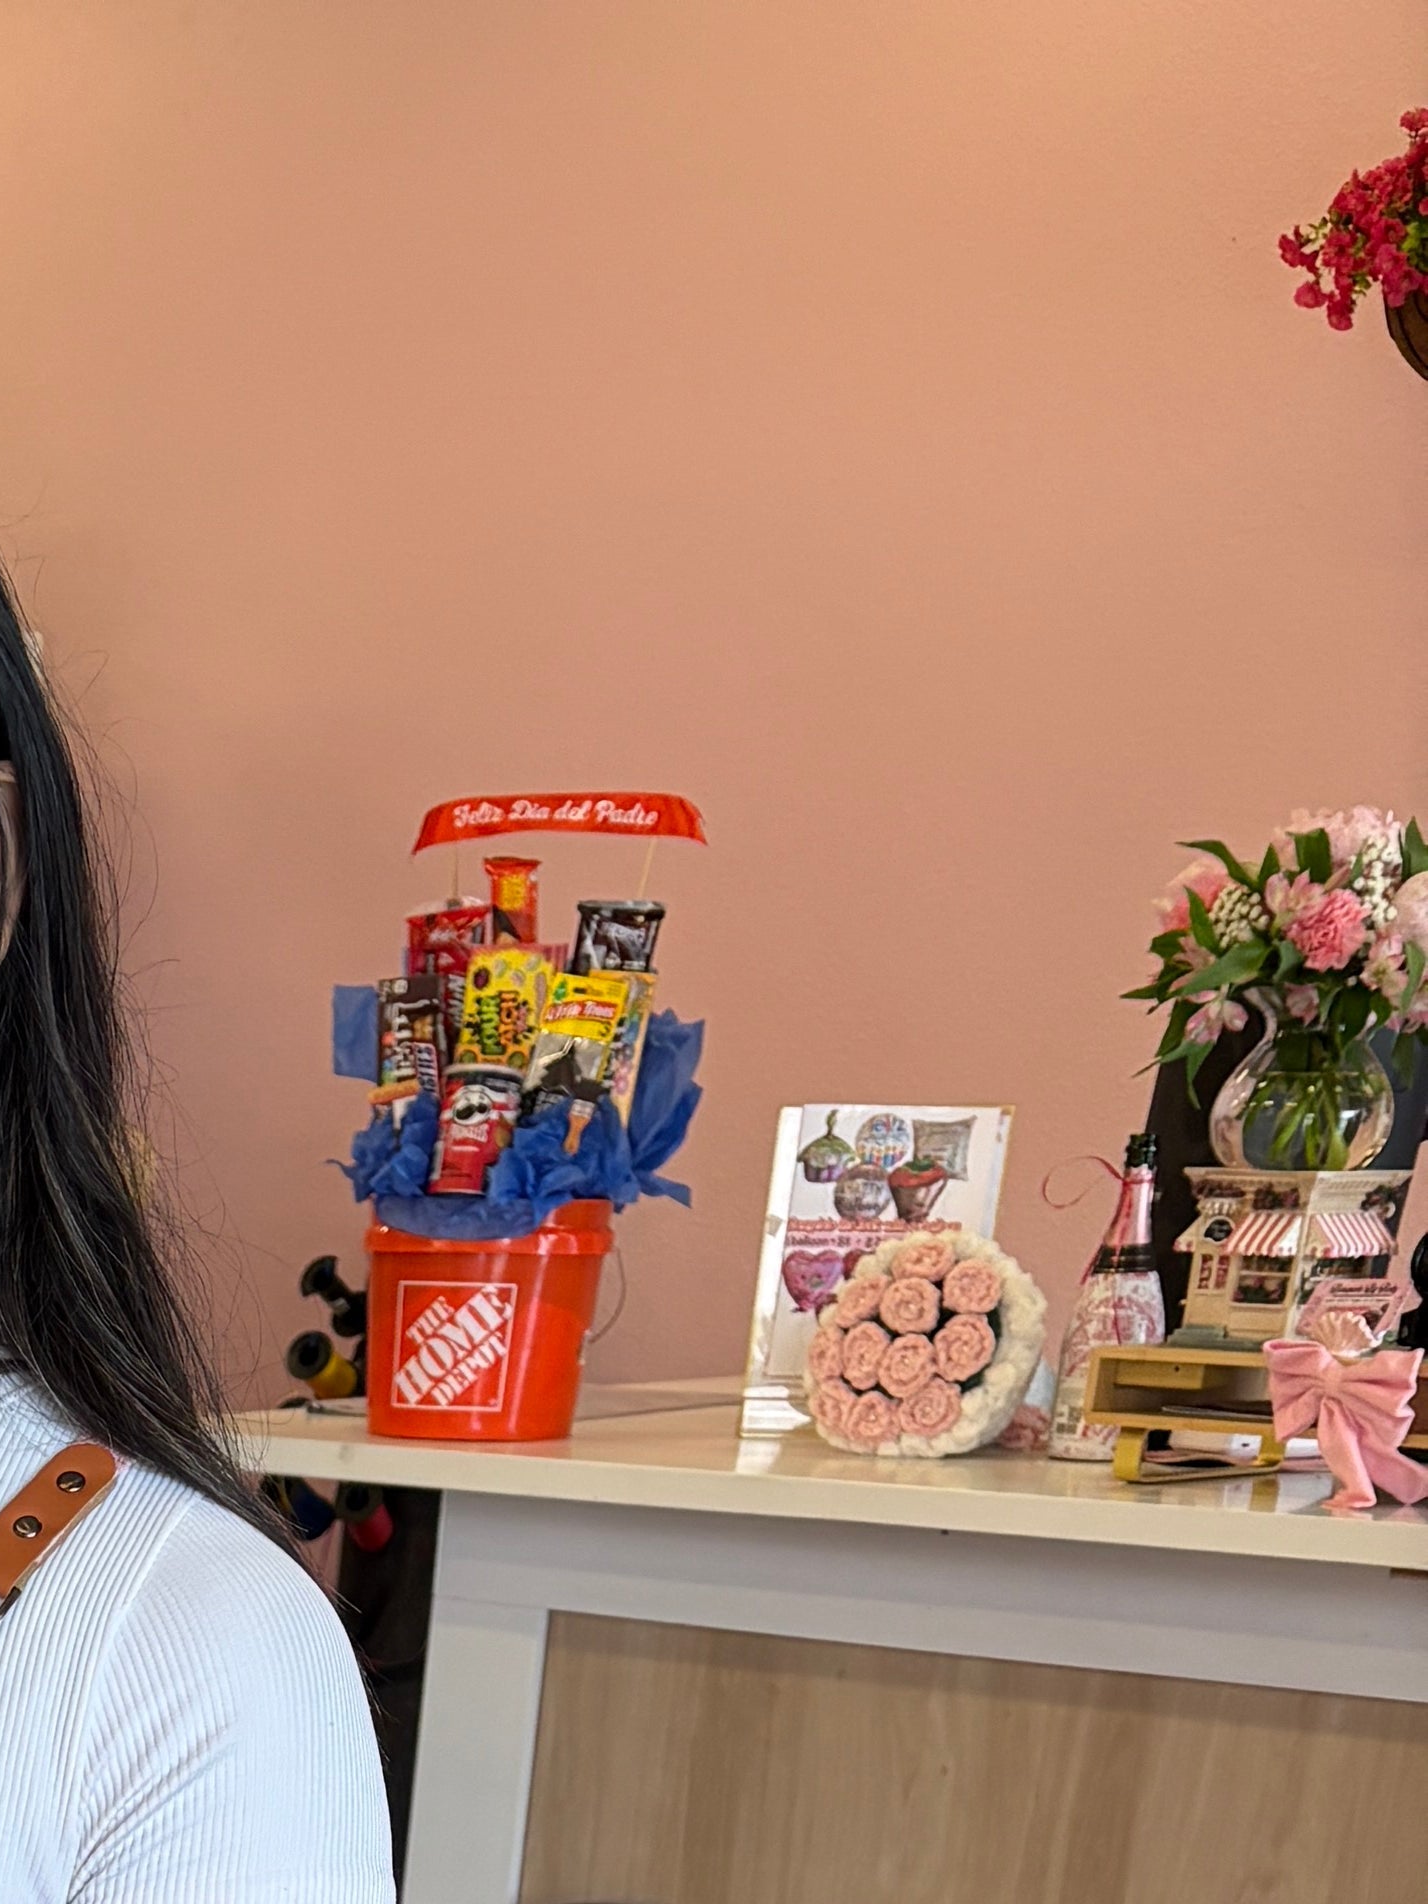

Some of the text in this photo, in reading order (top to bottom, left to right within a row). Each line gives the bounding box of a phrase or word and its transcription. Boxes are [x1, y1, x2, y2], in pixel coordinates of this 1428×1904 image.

[453, 802, 504, 828] Feliz
[553, 800, 592, 821] del
[595, 799, 659, 825] Padre
[395, 1285, 513, 1405] HOME
[405, 1296, 455, 1345] THE
[431, 1331, 507, 1407] DEPOT
